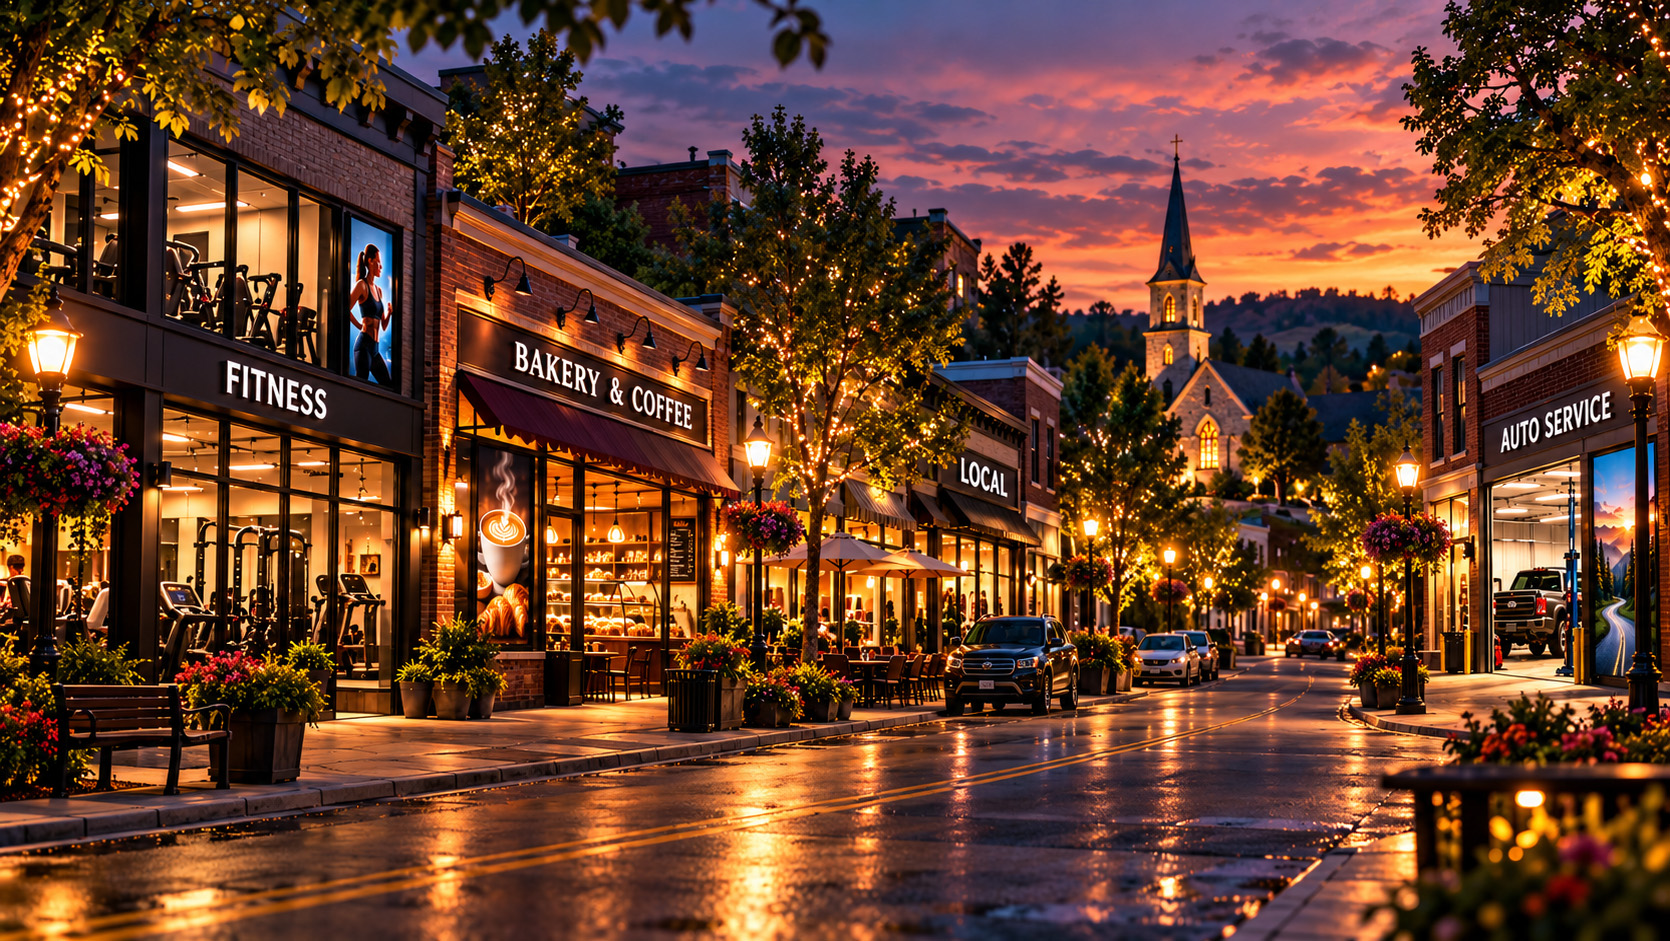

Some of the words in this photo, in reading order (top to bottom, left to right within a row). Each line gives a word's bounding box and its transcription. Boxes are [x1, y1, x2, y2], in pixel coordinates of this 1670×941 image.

[226, 360, 327, 420] FITNESS
[514, 341, 601, 398] BAKERY
[610, 376, 625, 406] &
[632, 385, 693, 430] COFFEE
[1500, 416, 1540, 453] AUTO
[1545, 390, 1612, 439] SERVICE
[960, 457, 1008, 498] LOCAL
